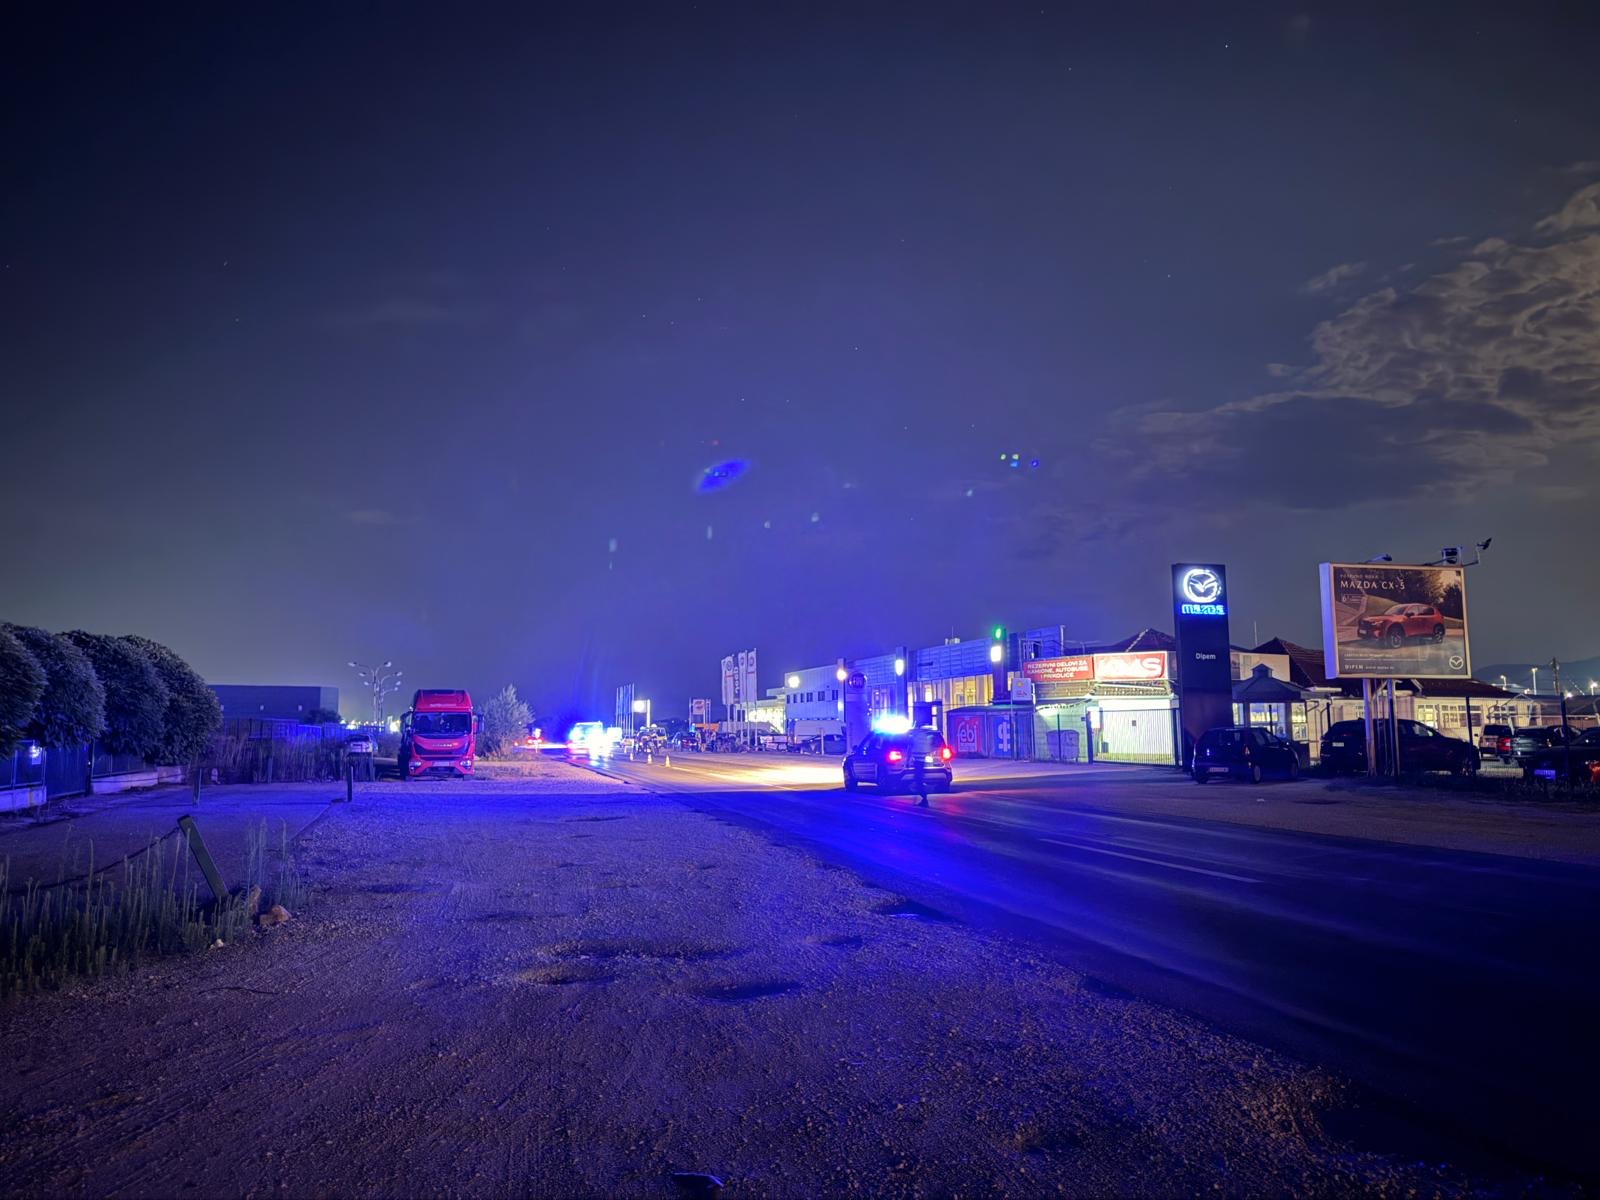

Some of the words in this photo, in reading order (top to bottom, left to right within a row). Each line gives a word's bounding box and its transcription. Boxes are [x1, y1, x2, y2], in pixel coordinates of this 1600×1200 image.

[1340, 580, 1378, 589] MAZDA
[1381, 580, 1405, 590] CX-5
[1195, 652, 1216, 660] Dipem
[1056, 660, 1078, 668] DELOVI
